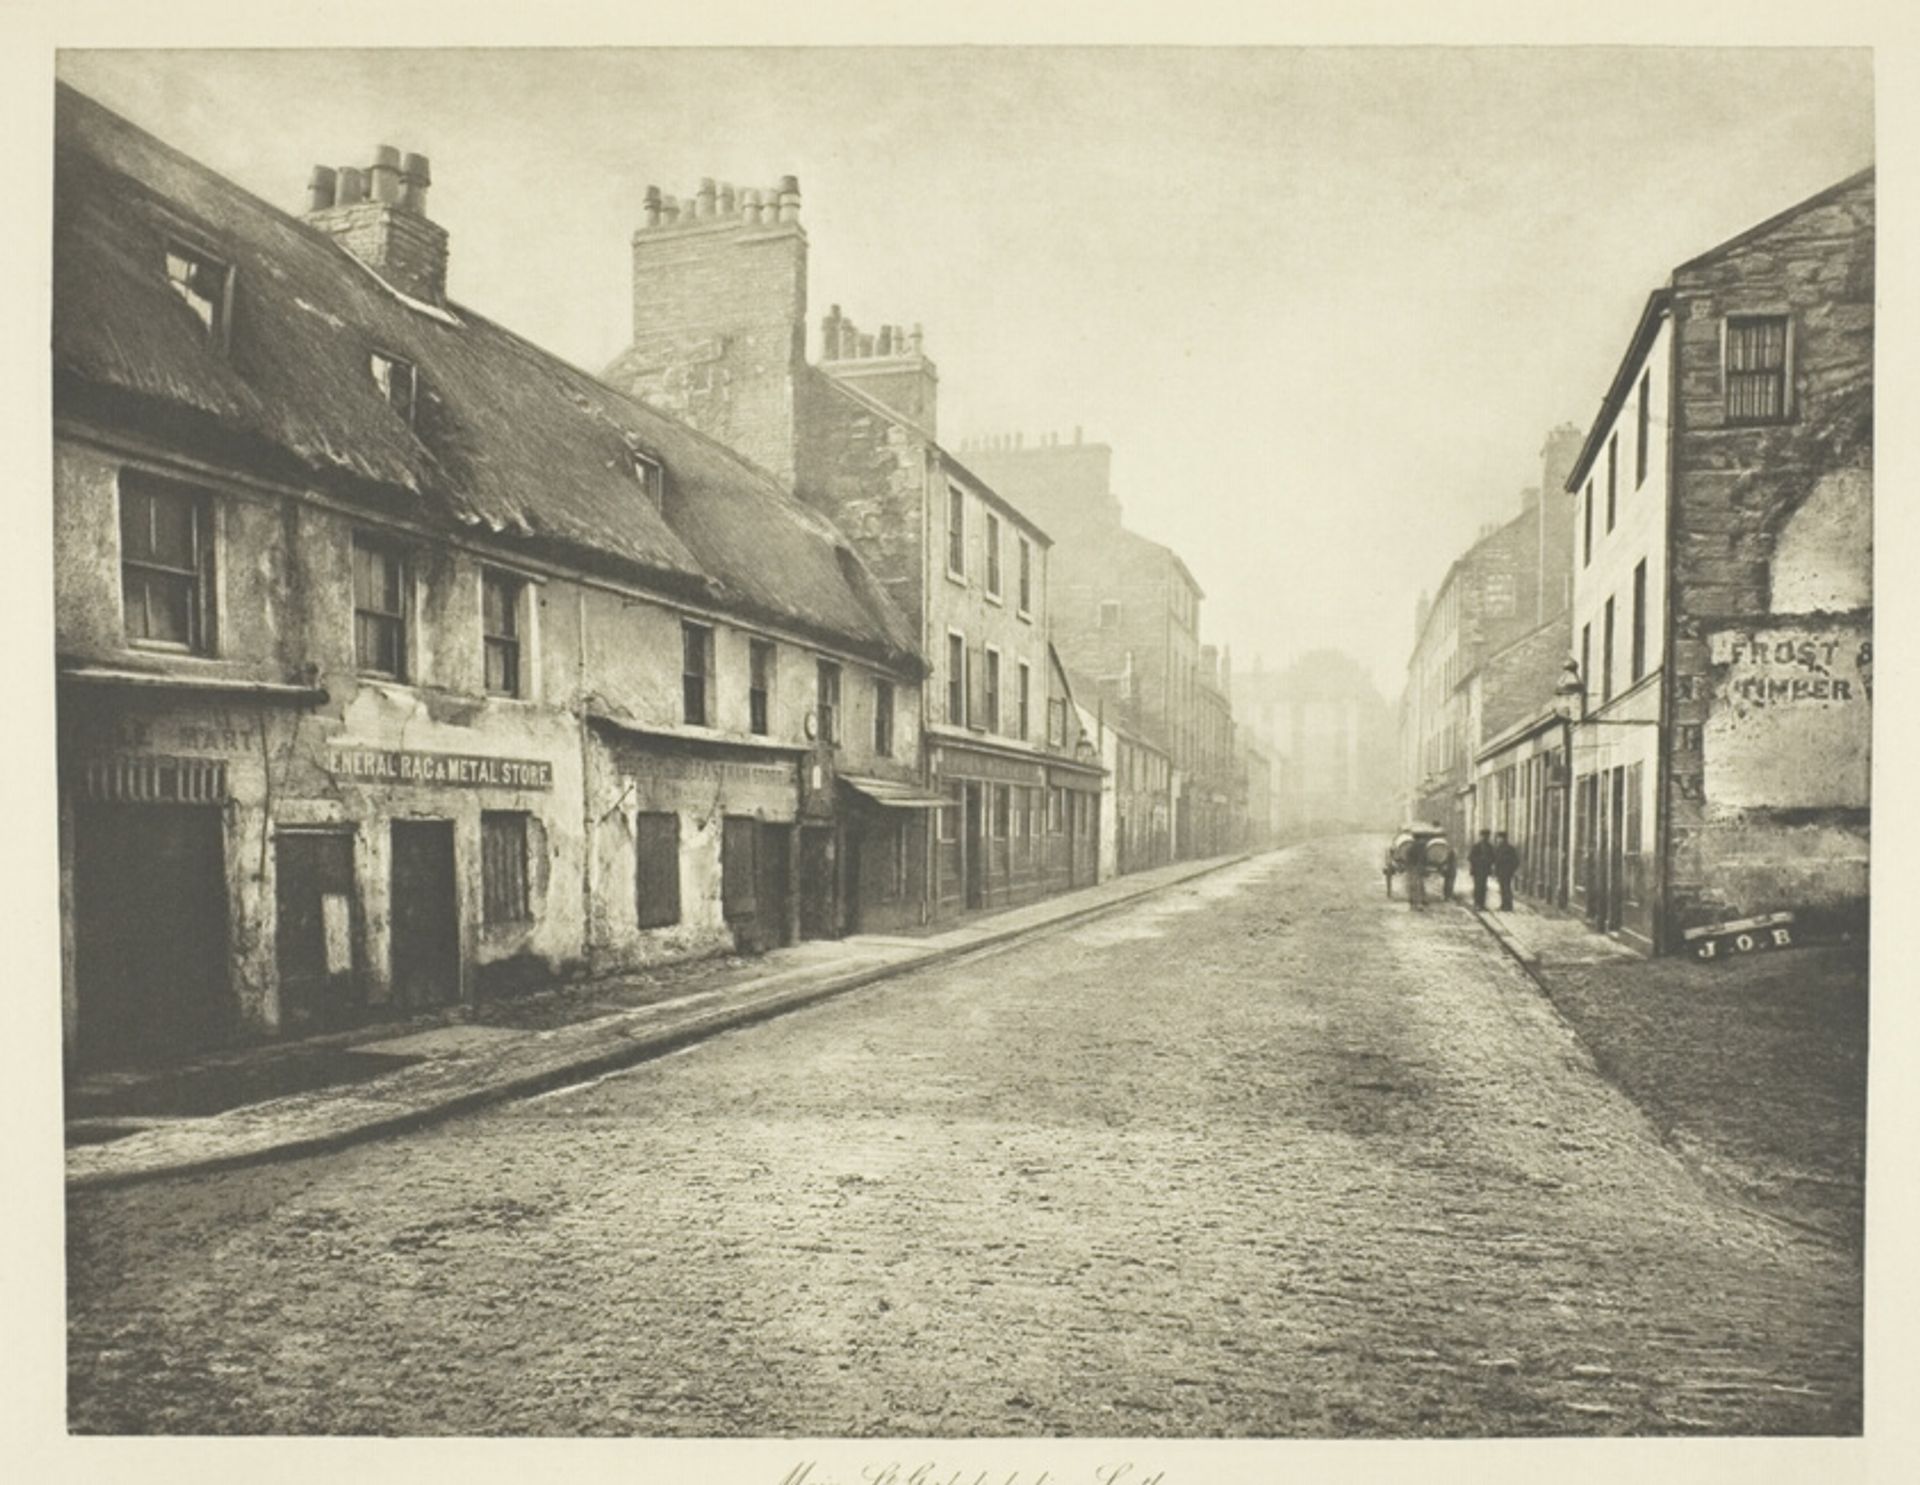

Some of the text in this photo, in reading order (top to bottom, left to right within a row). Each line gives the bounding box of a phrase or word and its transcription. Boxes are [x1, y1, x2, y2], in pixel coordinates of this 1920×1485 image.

[1730, 641, 1839, 667] FROST
[1733, 677, 1853, 700] TIMBER
[448, 758, 498, 783] METAL
